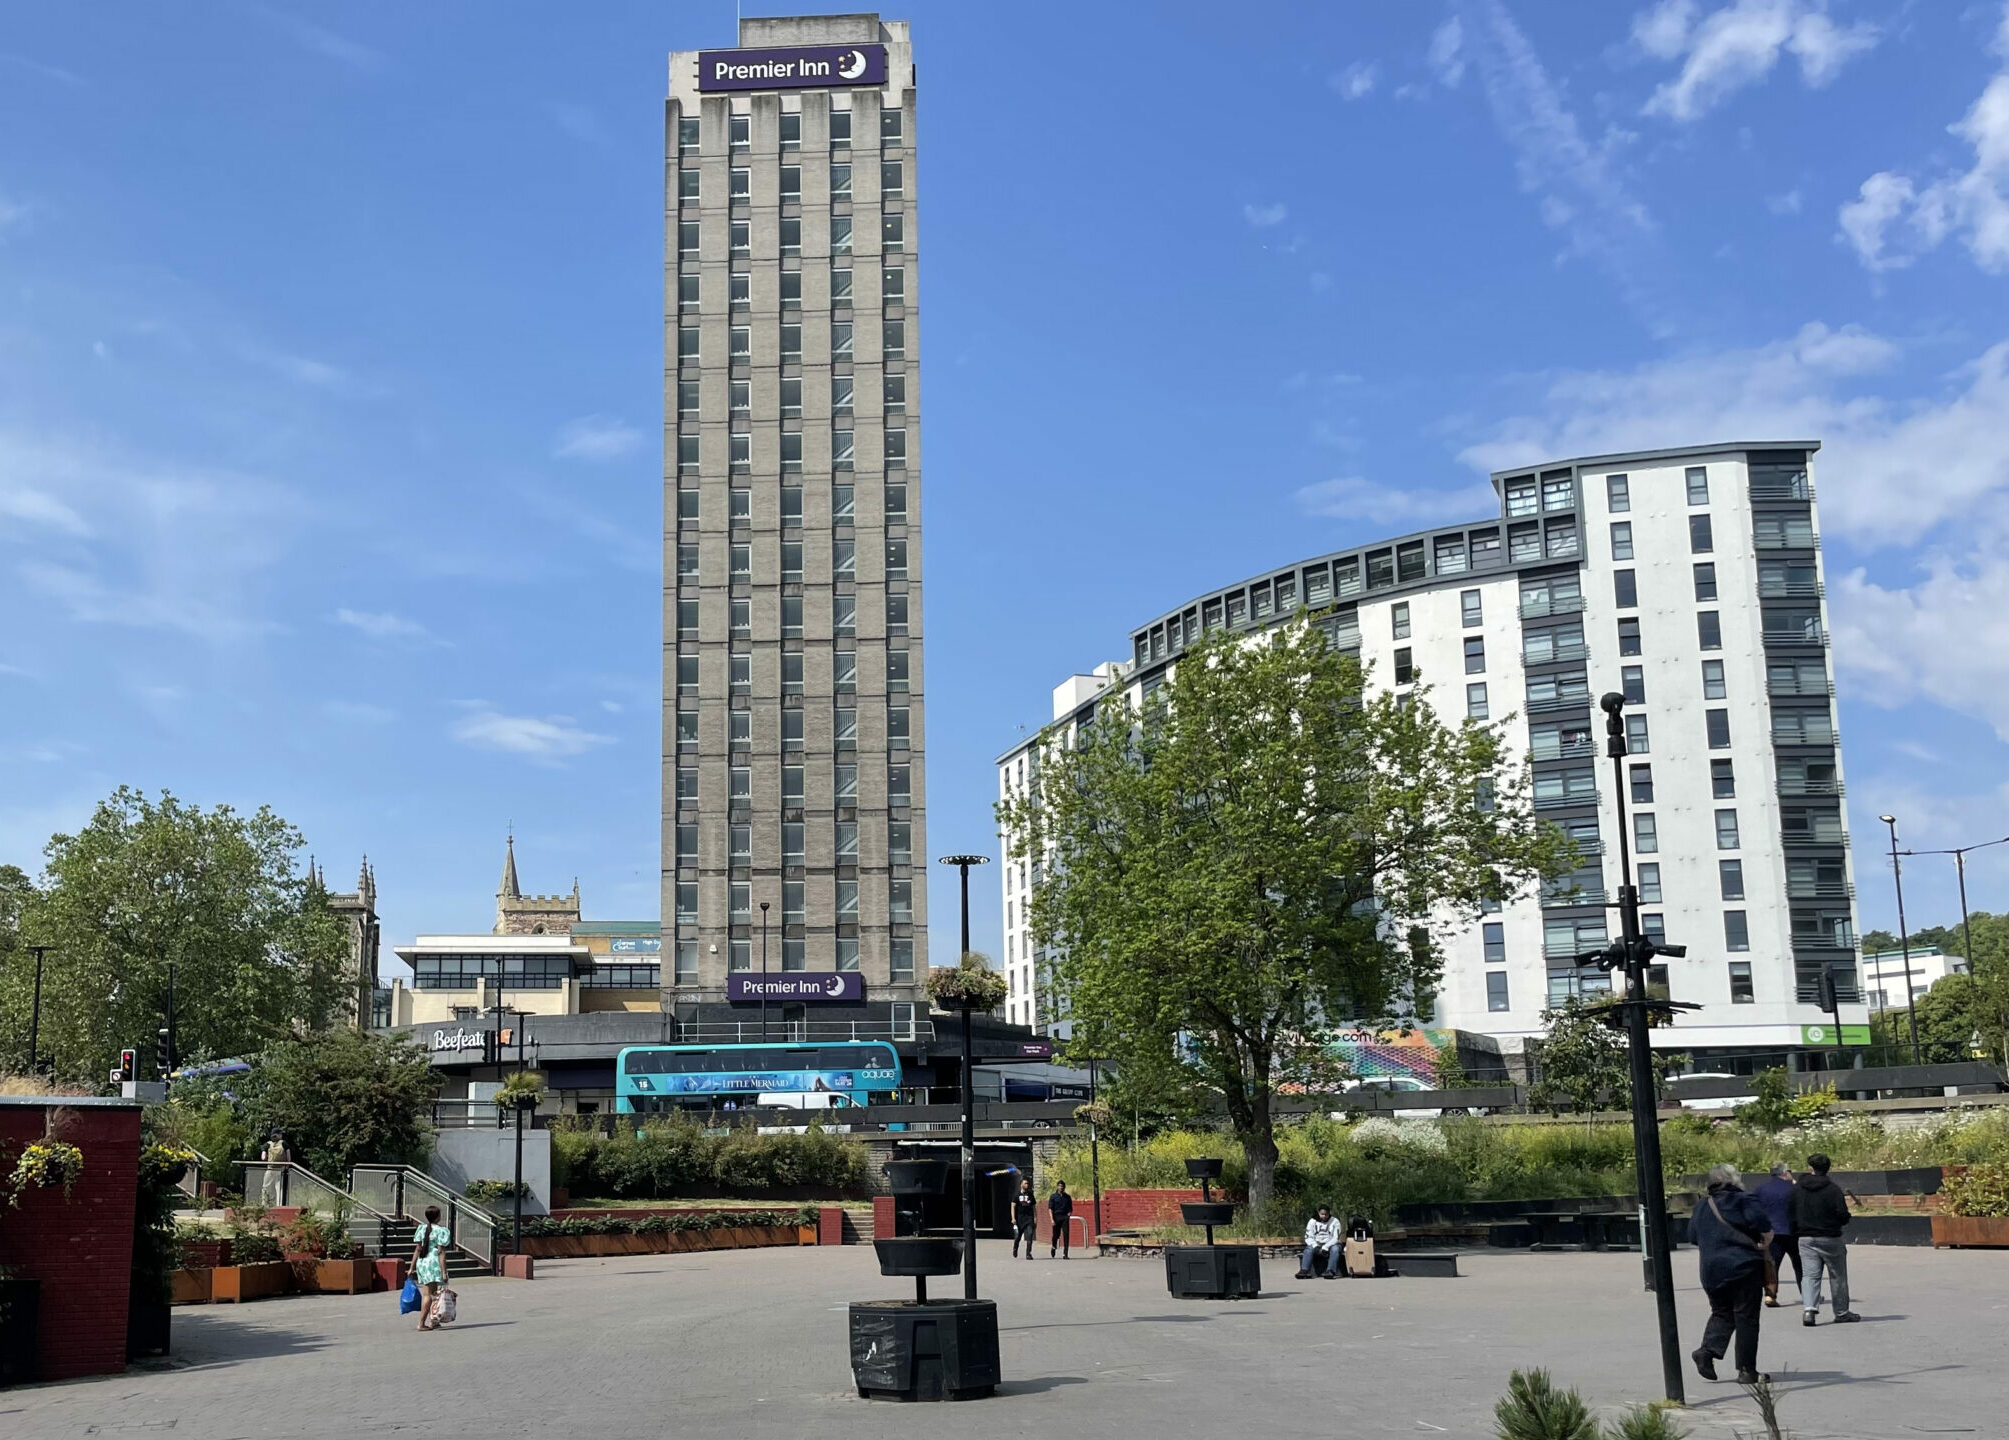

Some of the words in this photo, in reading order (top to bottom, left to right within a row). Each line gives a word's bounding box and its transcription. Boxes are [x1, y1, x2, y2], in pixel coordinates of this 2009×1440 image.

[715, 59, 795, 80] Premier
[800, 58, 830, 76] Inn
[743, 980, 796, 994] Premier
[800, 980, 820, 993] Inn
[722, 1079, 749, 1088] LITTLE
[750, 1077, 789, 1089] MERMAID
